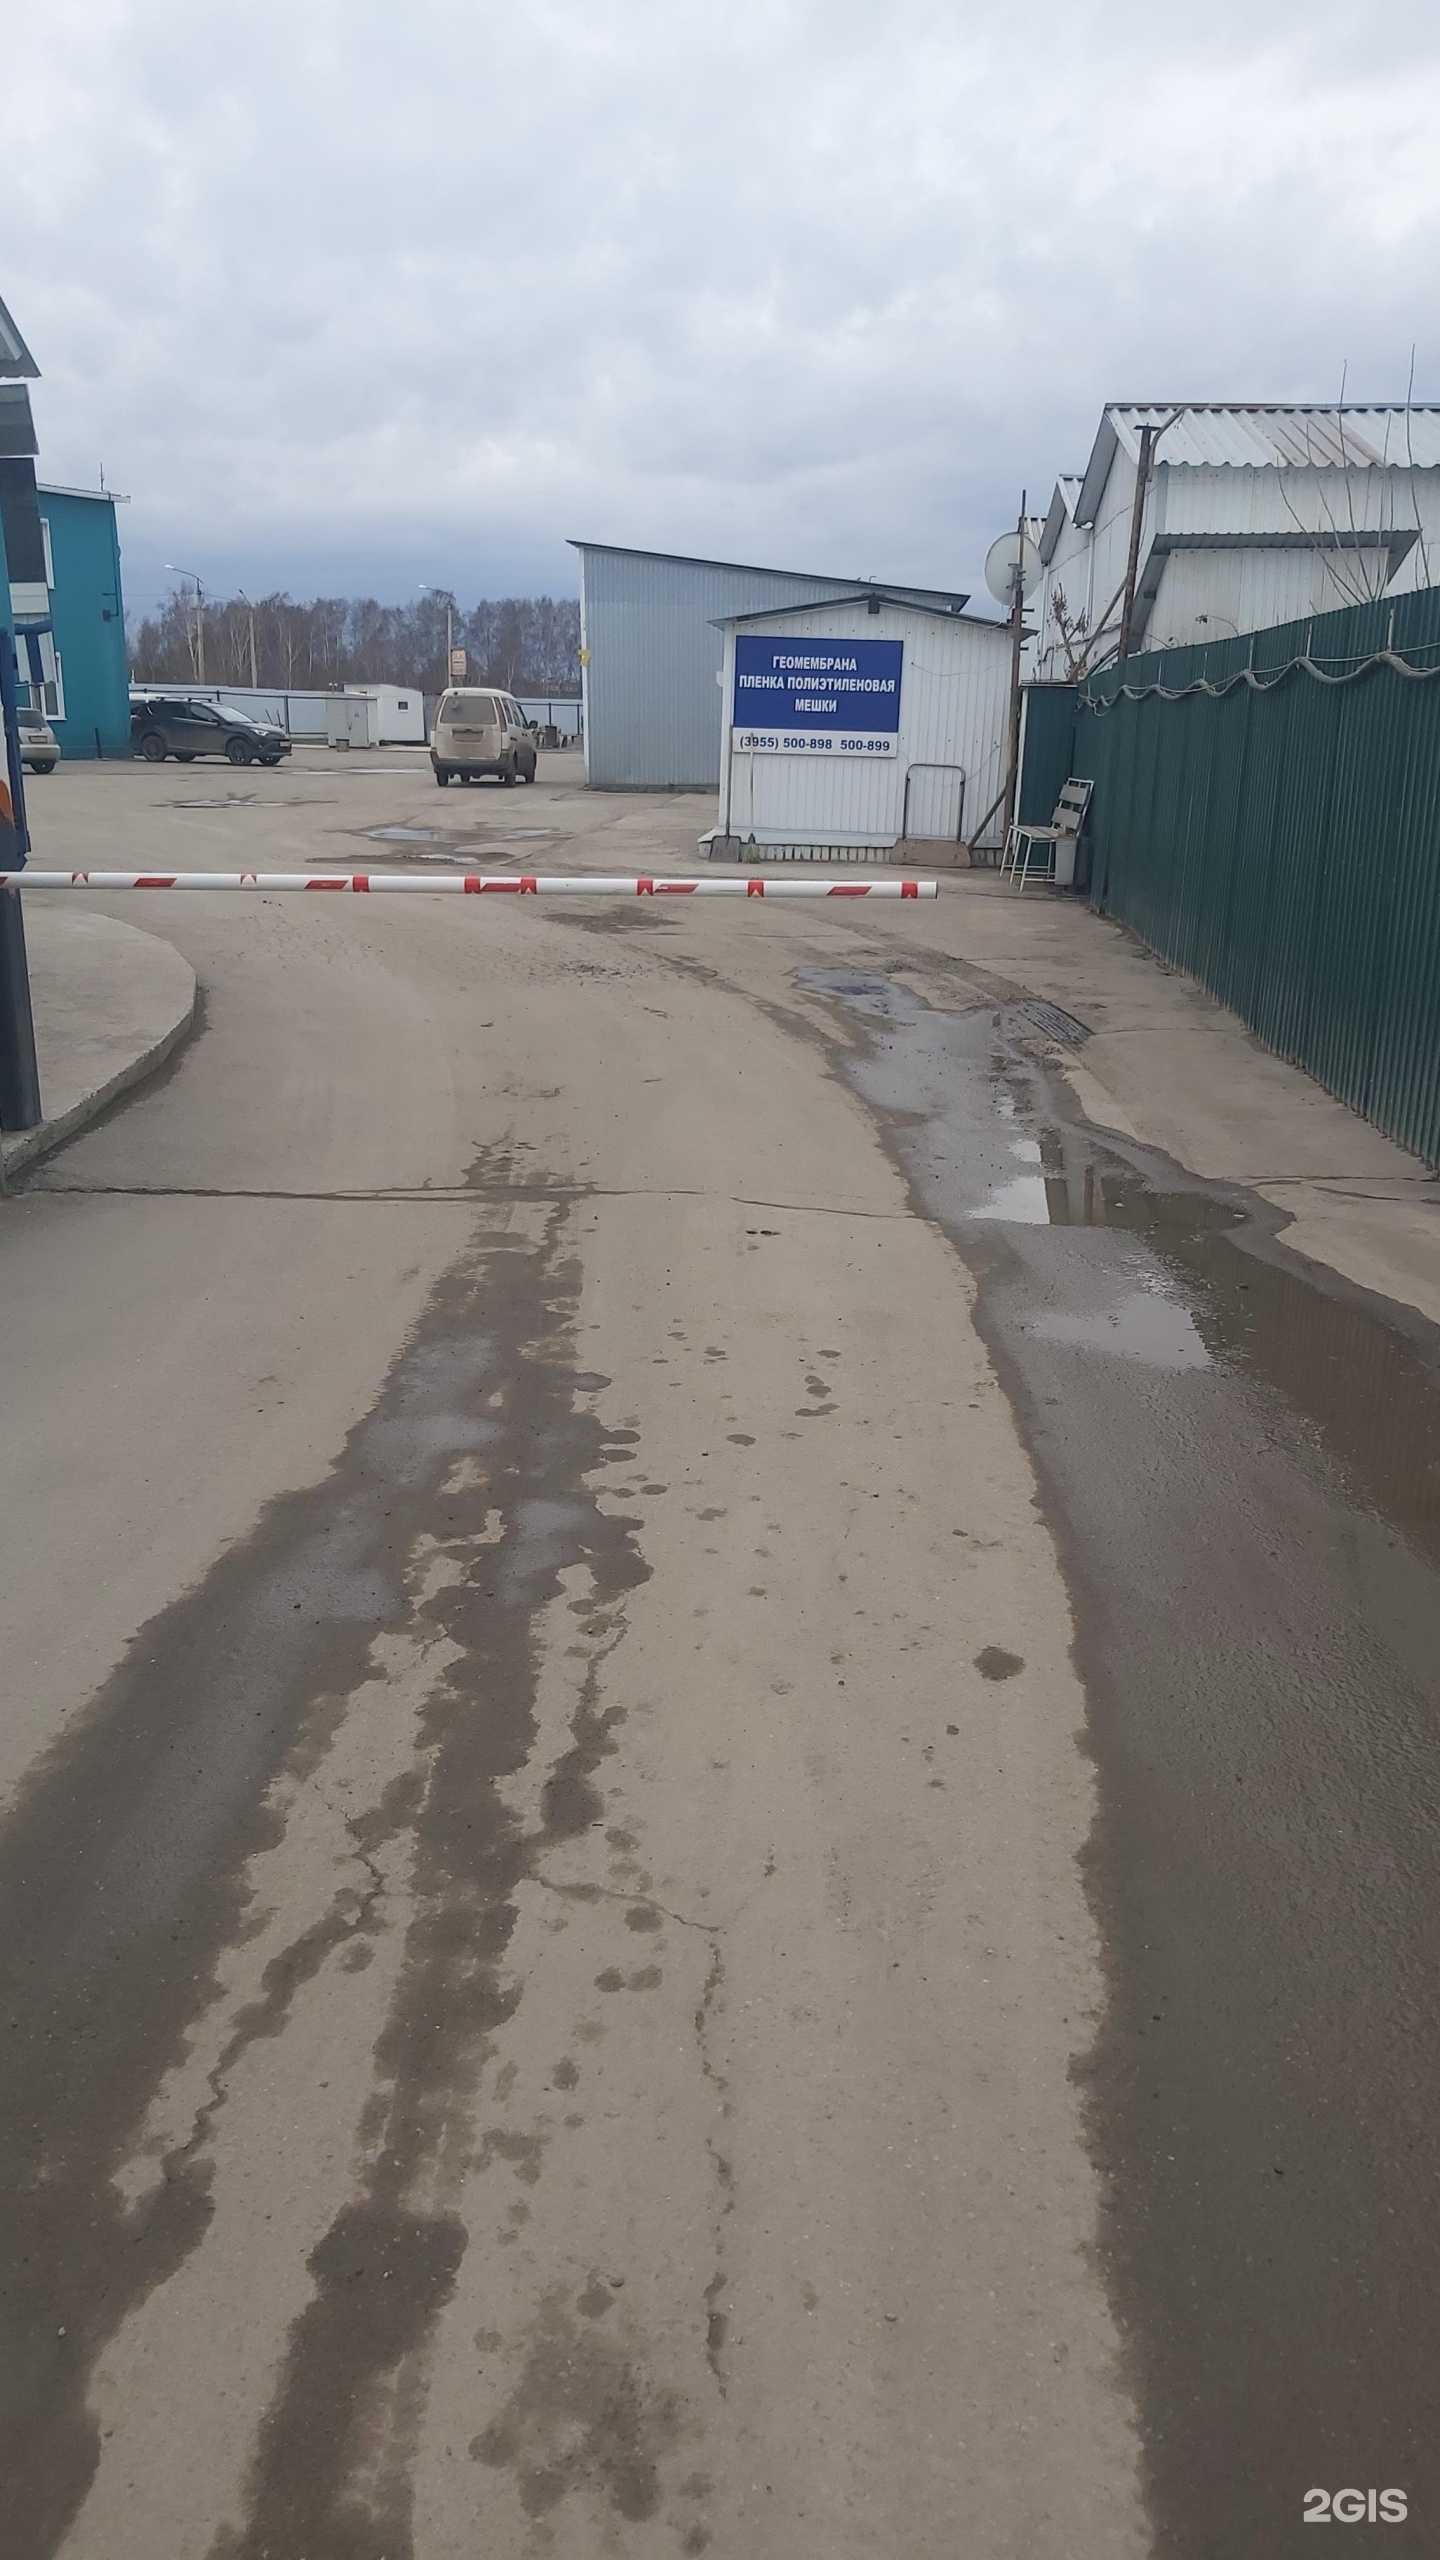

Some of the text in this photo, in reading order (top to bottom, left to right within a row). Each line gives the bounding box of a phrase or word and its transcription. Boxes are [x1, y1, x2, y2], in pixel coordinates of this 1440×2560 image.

[772, 656, 857, 671] ГЕОМЕМБРАНА
[739, 675, 895, 692] ПЛЕНКА ПОЛИЭТИЛЕНОВАЯ
[795, 699, 837, 713] МЕШКИ
[740, 736, 890, 751] (3955) 500-898 500-899
